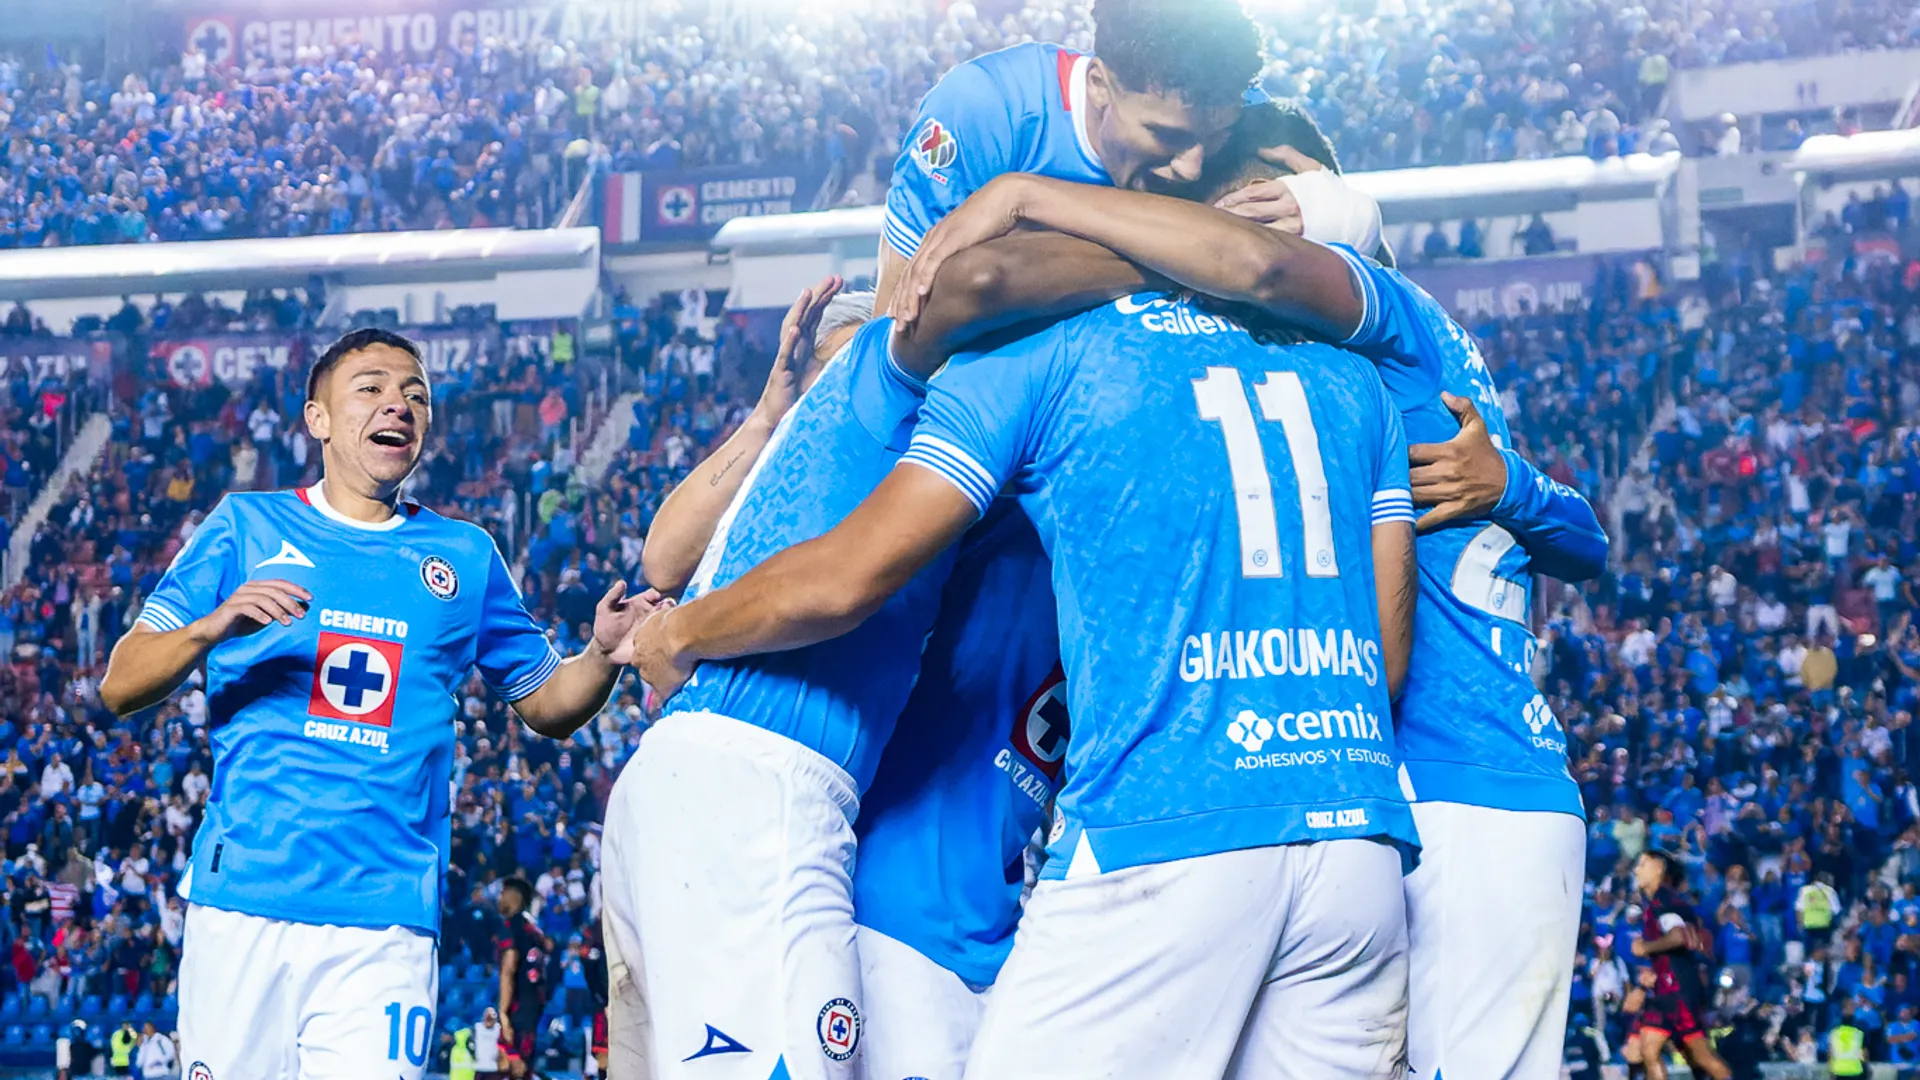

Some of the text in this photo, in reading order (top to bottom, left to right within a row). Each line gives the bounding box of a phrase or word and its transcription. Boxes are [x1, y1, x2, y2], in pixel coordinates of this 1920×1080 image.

[243, 13, 436, 62] CEMENTO
[702, 176, 796, 200] CEMENTO
[1191, 366, 1341, 578] 11
[319, 608, 409, 638] CEMENTO
[303, 720, 390, 749] CRUZ AZUL
[1276, 702, 1383, 742] cemix
[1234, 750, 1327, 771] ADHESIVOS
[1330, 748, 1342, 762] Y
[1305, 808, 1370, 829] CRUZ AZUL
[385, 1002, 433, 1068] 10
